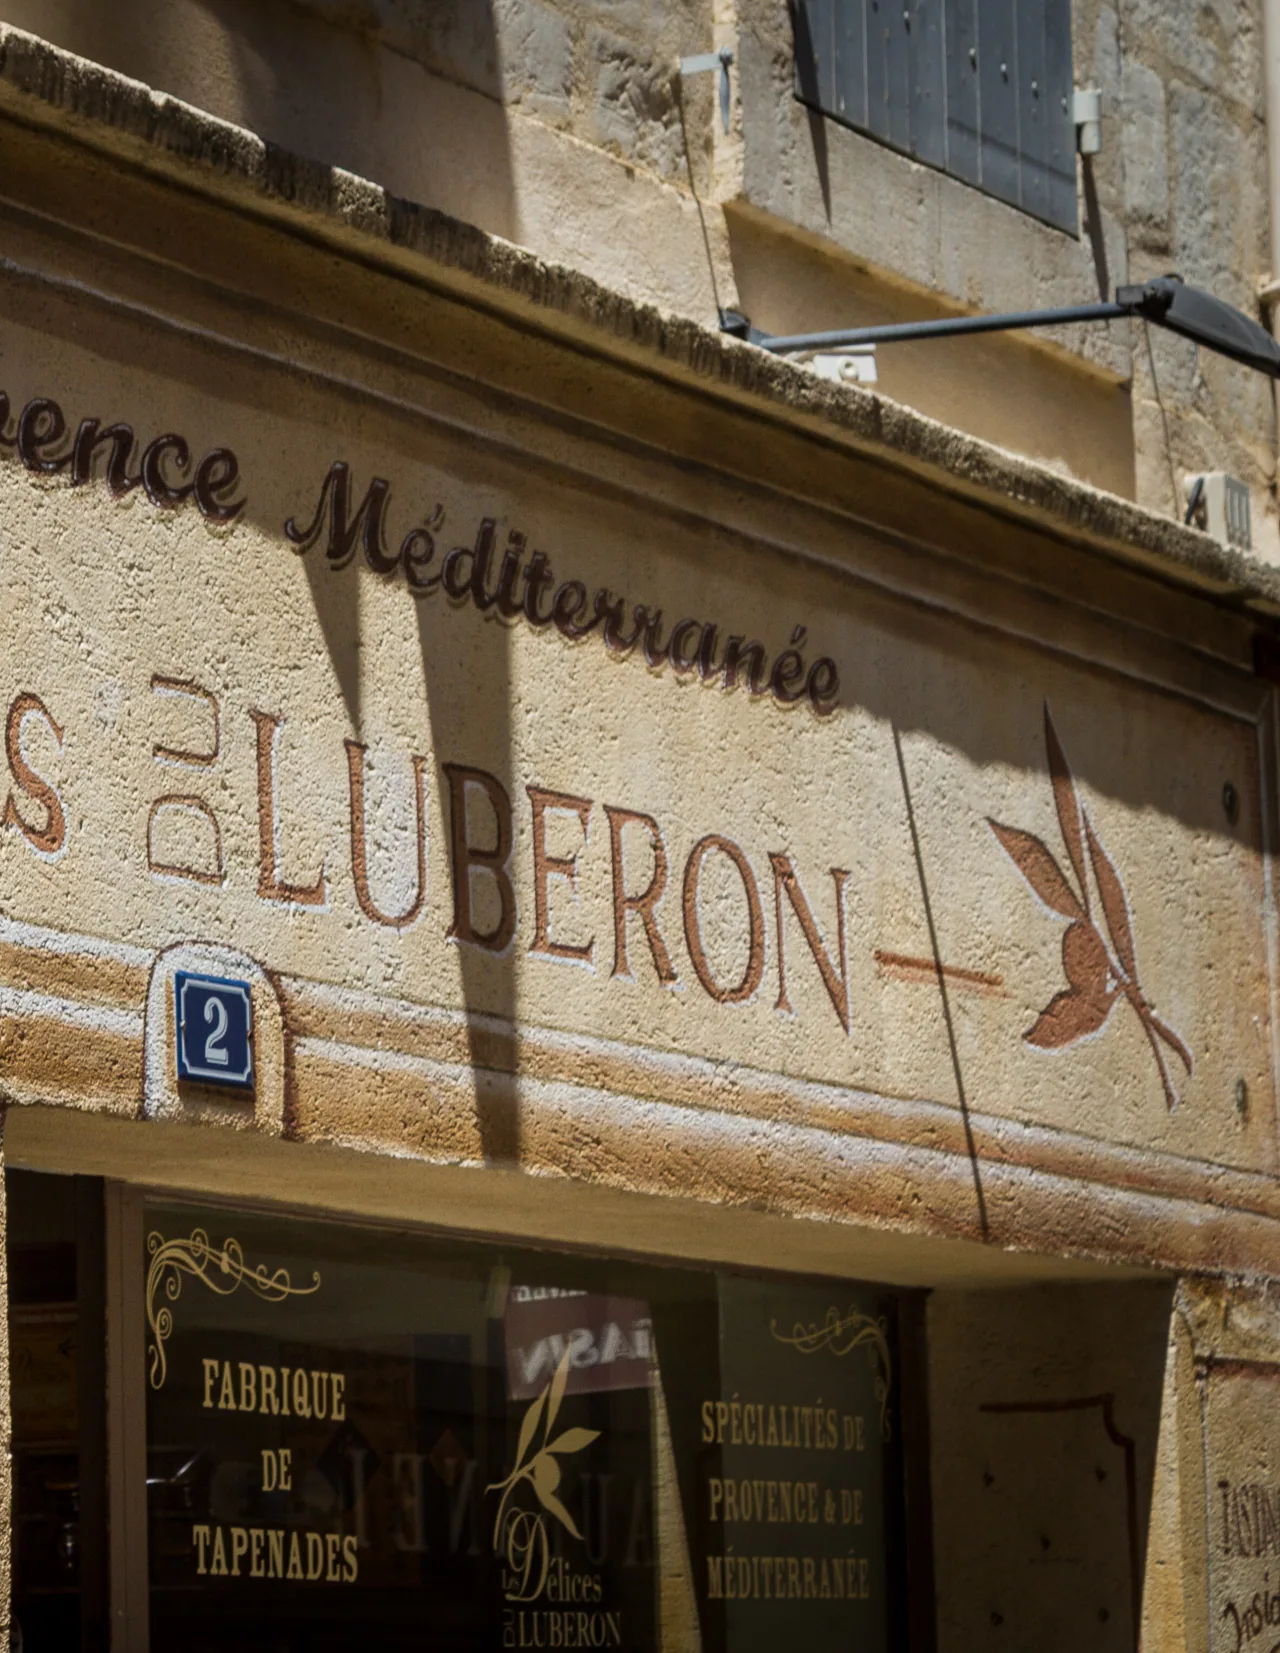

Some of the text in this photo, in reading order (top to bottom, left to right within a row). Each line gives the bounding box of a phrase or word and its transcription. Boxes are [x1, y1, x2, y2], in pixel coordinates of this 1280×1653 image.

[284, 461, 838, 716] Méditerranée
[147, 673, 226, 888] DU
[249, 708, 853, 1036] LUBERON
[204, 996, 229, 1065] 2
[202, 1358, 346, 1421] FABRIQUE
[701, 1392, 865, 1451] SPÉCIALITÉS DE
[261, 1448, 293, 1492] DE
[708, 1477, 863, 1525] PROVENCE & DE
[192, 1524, 359, 1584] TAPENADES
[503, 1507, 602, 1602] Délices
[706, 1544, 869, 1600] MÉDITERRANÉE
[517, 1610, 621, 1648] LUBERON
